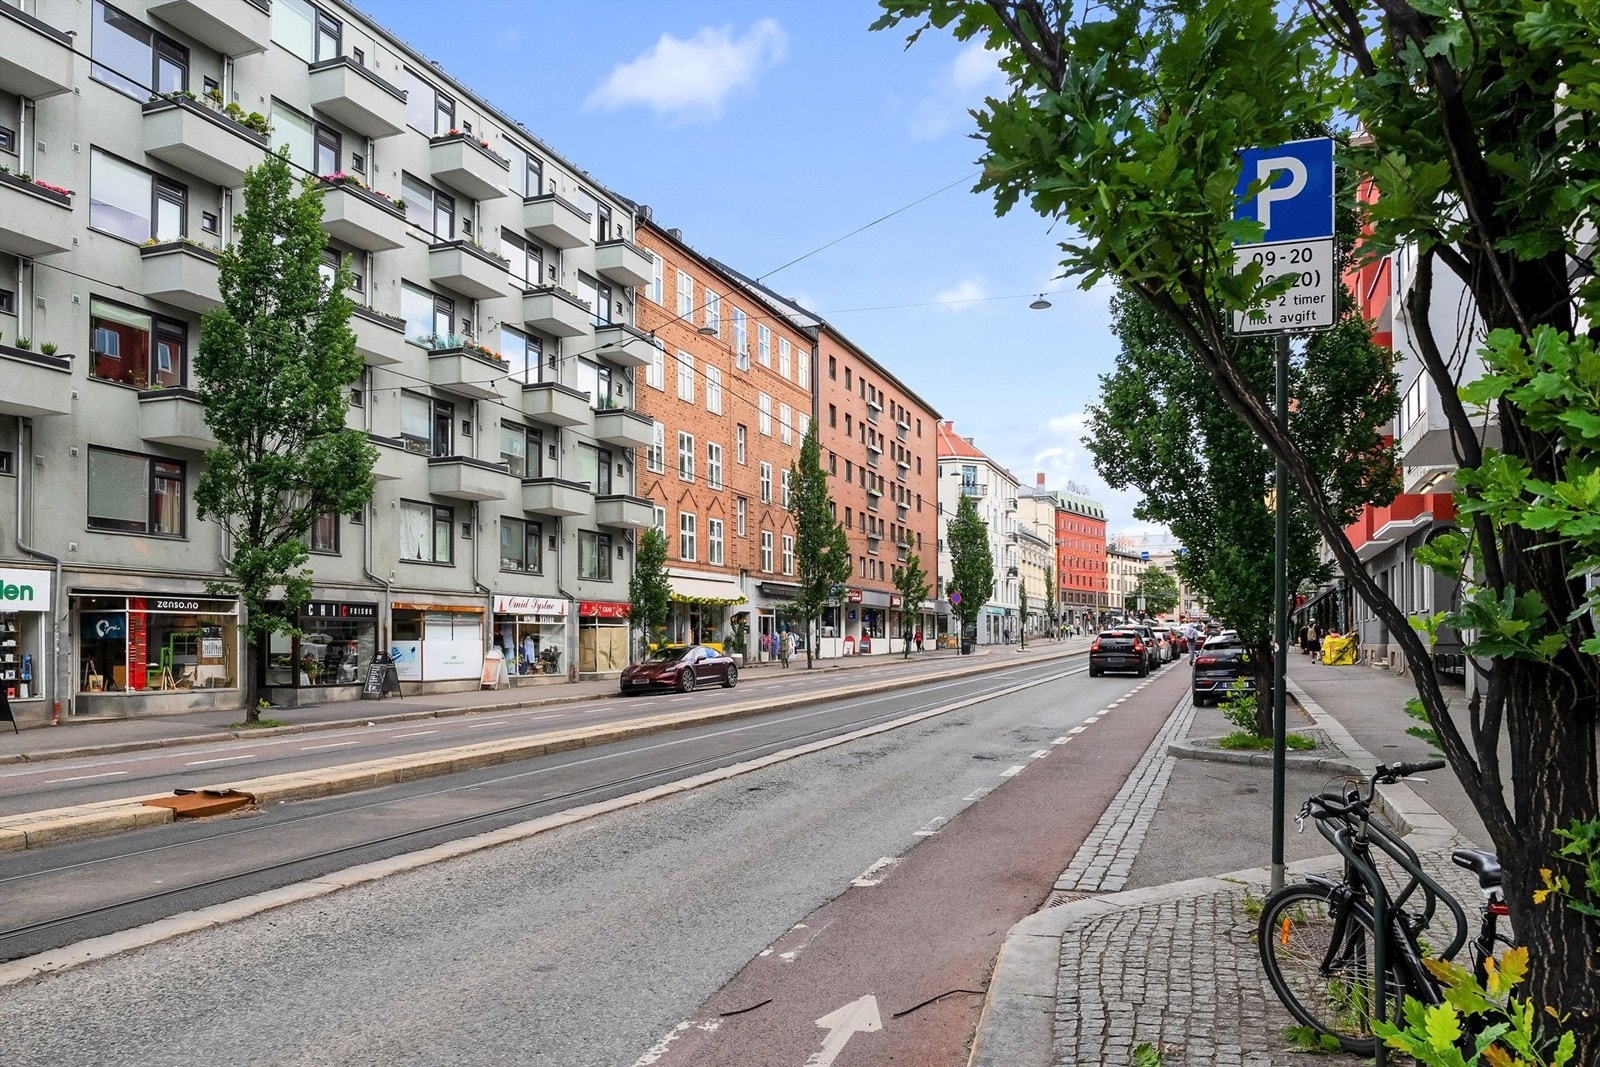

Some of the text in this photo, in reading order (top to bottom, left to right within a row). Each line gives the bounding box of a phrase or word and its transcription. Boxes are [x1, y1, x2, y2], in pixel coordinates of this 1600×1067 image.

[1257, 156, 1308, 230] P
[1278, 296, 1286, 307] 2
[1293, 294, 1326, 306] timer
[1279, 309, 1317, 324] avgift
[157, 600, 199, 610] zenso.no
[508, 596, 530, 609] Omid
